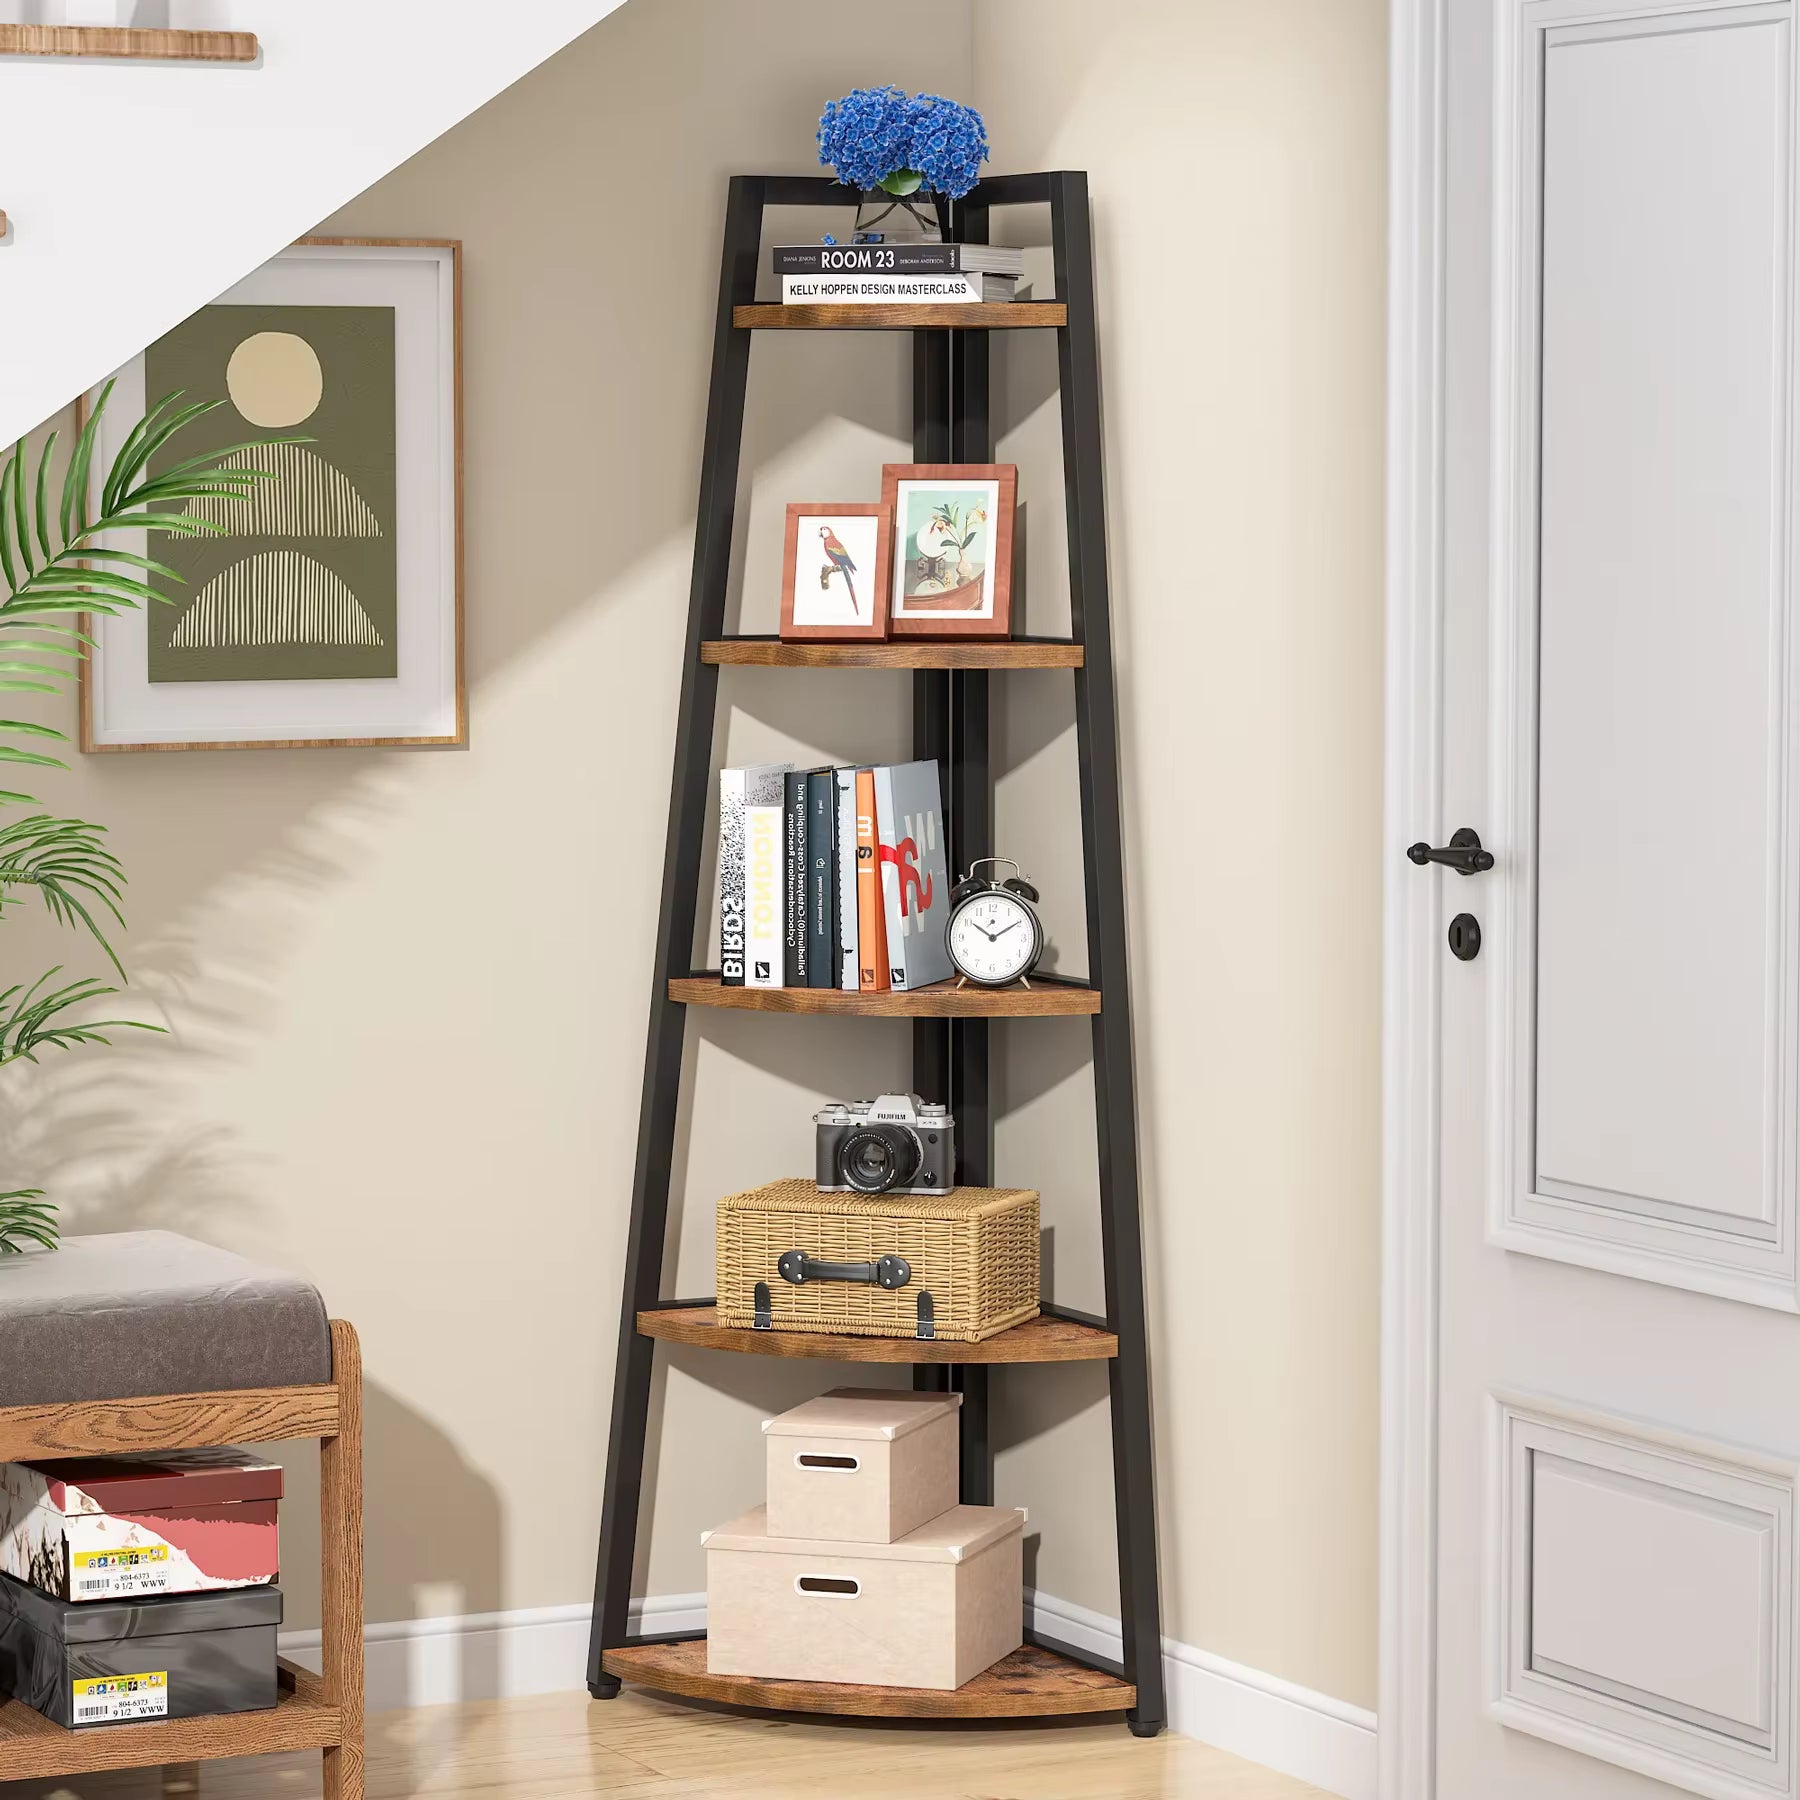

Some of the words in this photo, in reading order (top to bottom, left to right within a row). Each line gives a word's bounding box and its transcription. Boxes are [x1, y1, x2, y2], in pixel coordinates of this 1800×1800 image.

[821, 250, 872, 269] ROOM
[875, 250, 895, 268] 23
[790, 284, 819, 296] KELLY
[821, 284, 859, 295] HOPPEN
[861, 283, 896, 295] DESIGN
[897, 283, 967, 295] MASTERCLASS
[975, 907, 983, 917] 11
[988, 903, 998, 913] 12
[958, 933, 965, 942] 9
[1020, 934, 1027, 943] 3
[962, 949, 969, 957] 8
[975, 959, 980, 968] 7
[1005, 959, 1012, 968] 5
[988, 964, 995, 973] 6
[120, 1572, 150, 1582] 804-6373
[114, 1583, 120, 1591] 9
[122, 1582, 133, 1591] 1/2
[141, 1579, 166, 1589] WWW
[118, 1699, 148, 1708] 804-6373
[113, 1709, 119, 1718] 9
[120, 1708, 132, 1717] 1/2
[139, 1705, 165, 1715] WWW
